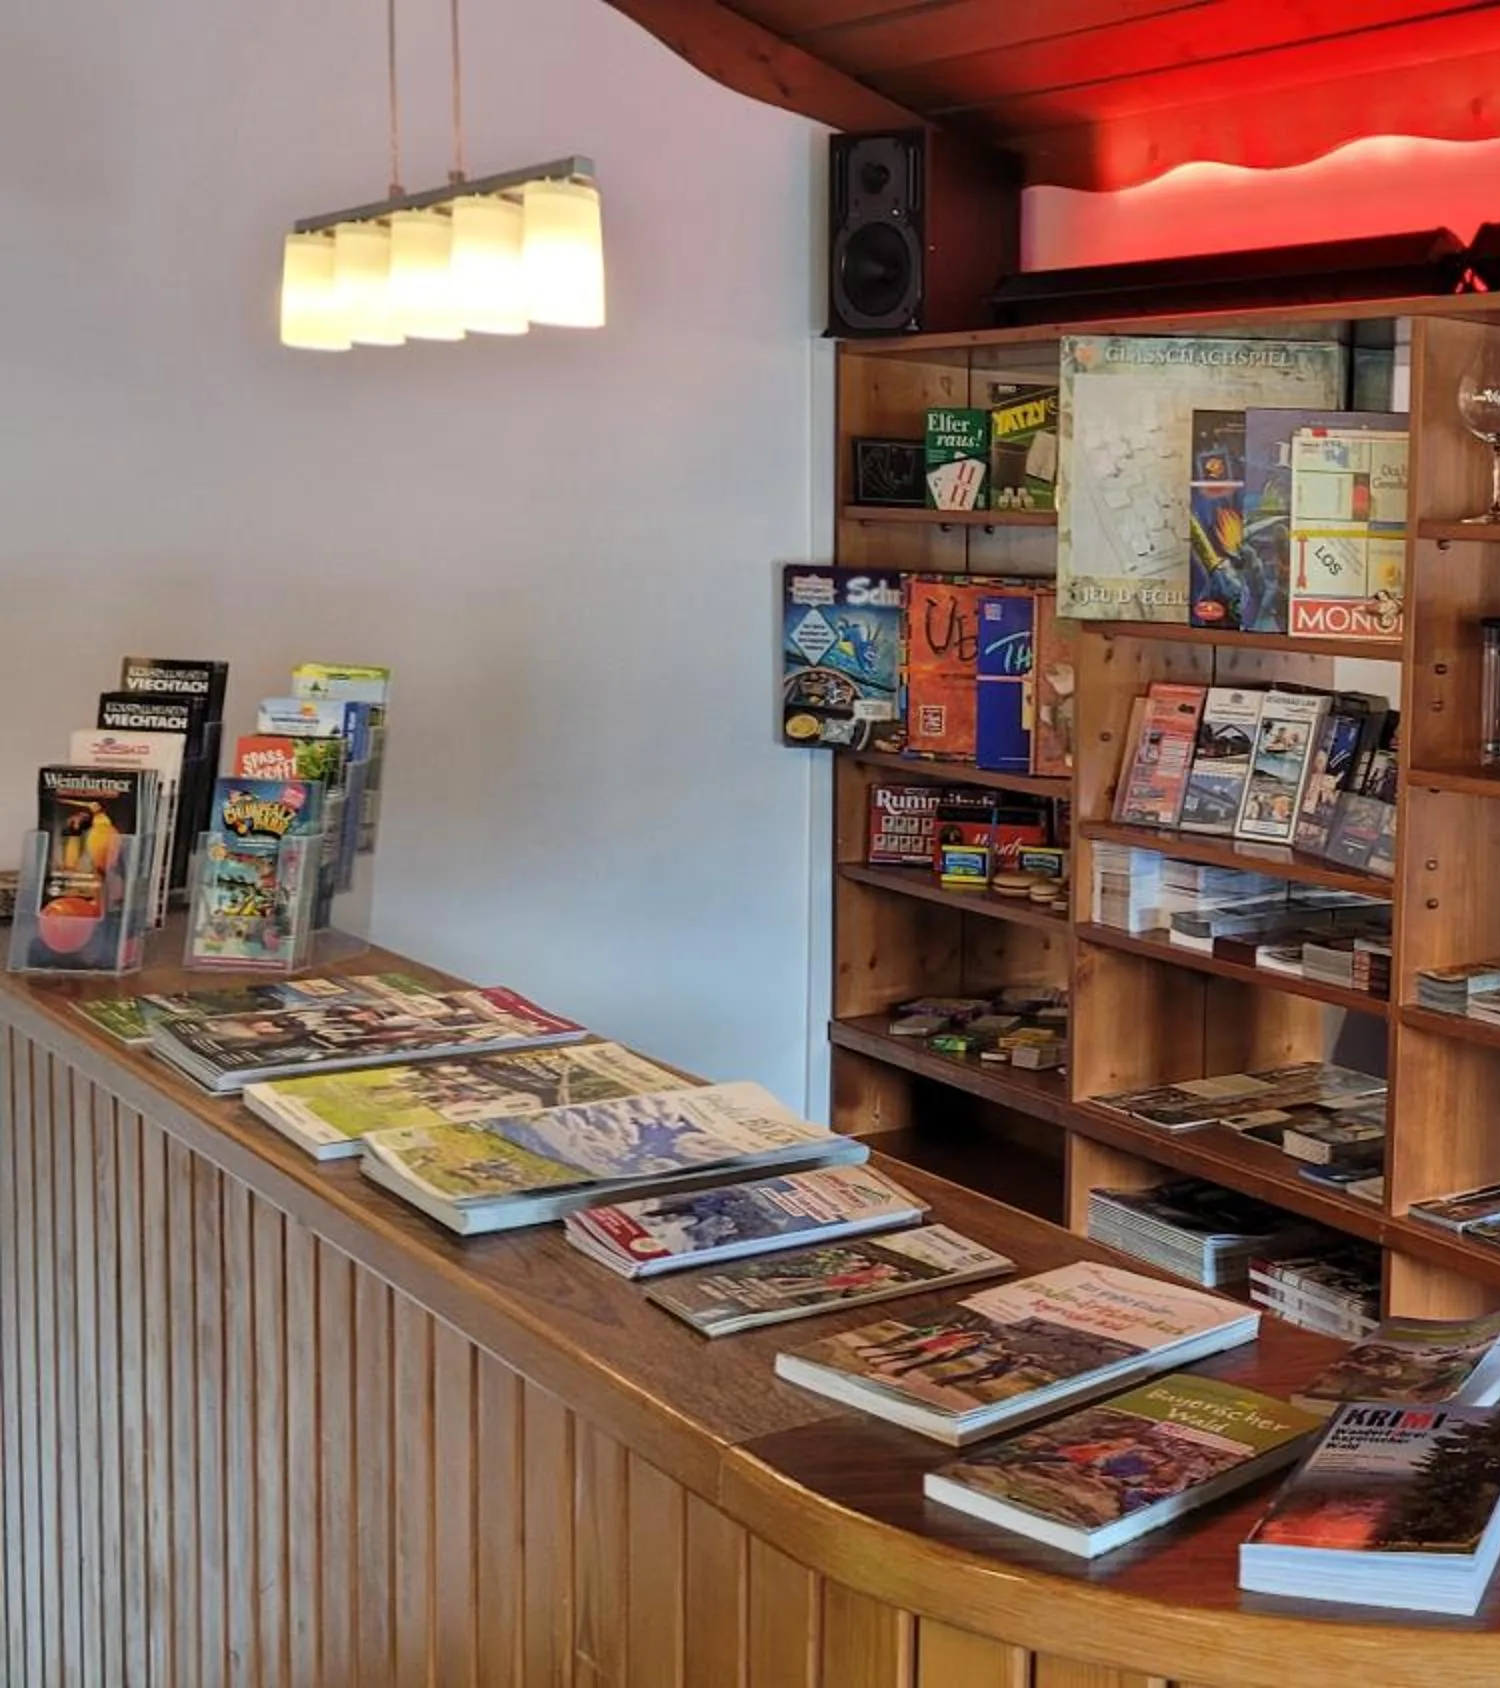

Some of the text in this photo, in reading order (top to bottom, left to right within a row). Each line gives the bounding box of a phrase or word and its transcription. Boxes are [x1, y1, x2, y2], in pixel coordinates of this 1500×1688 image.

[927, 413, 971, 433] Elfer
[991, 398, 1045, 436] YATZY
[936, 428, 984, 448] raus!
[1313, 544, 1343, 577] LOS
[126, 677, 209, 693] VIECHTACH
[103, 713, 189, 729] VIECHTACH
[43, 772, 132, 793] Weinfurtner
[1167, 1407, 1232, 1433] Wald
